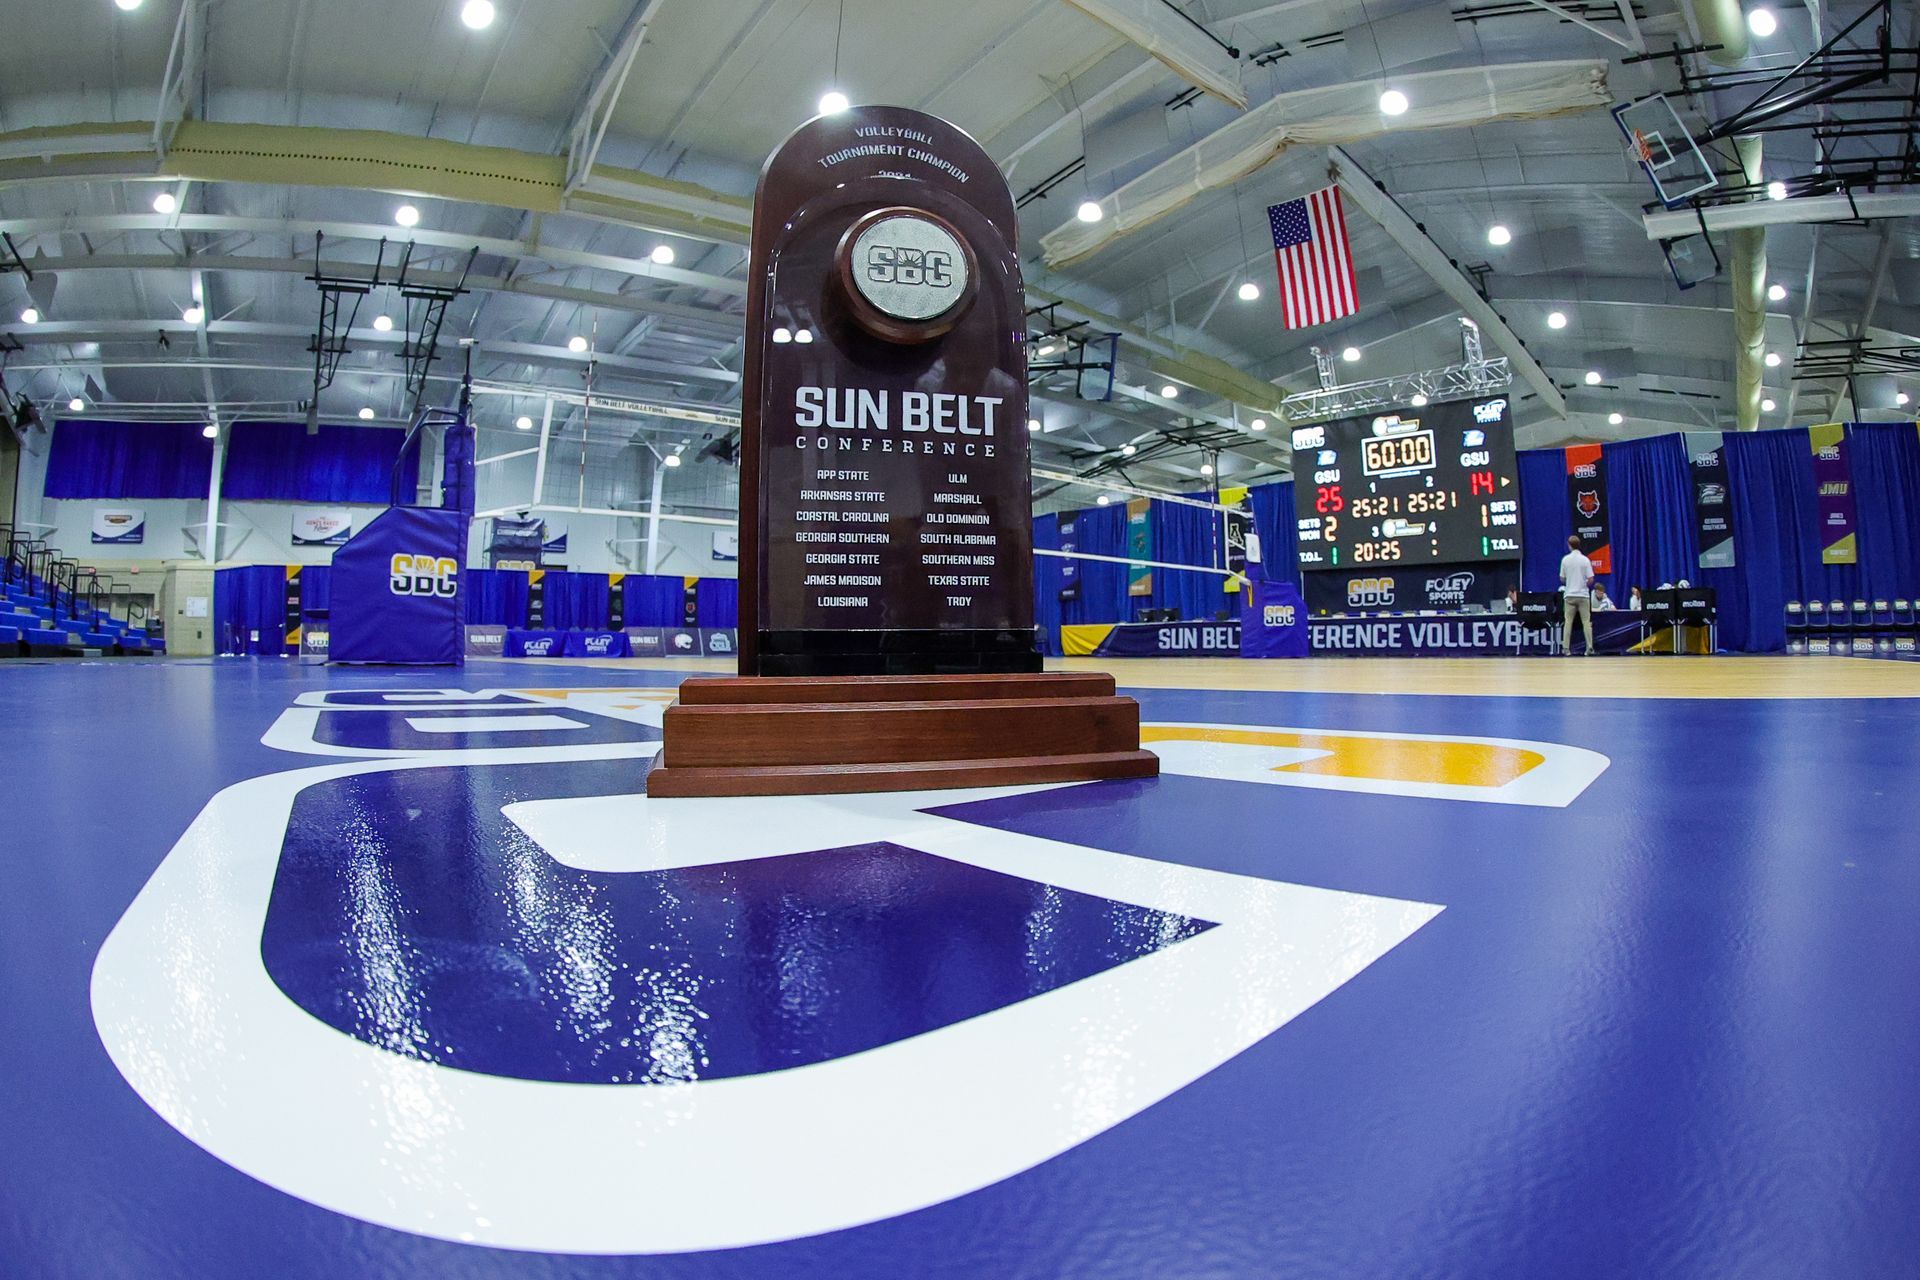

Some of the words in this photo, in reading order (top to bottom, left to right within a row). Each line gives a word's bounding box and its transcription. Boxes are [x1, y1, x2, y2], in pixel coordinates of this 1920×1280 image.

[855, 127, 934, 146] VOLLEYBALL
[817, 144, 904, 169] TOURNAMENT
[907, 148, 970, 183] CHAMPION
[867, 245, 952, 287] SBC
[795, 386, 888, 430] SUN
[902, 391, 1003, 436] BELT
[796, 436, 995, 457] CONFERENCE
[1367, 436, 1430, 469] 60:00
[1460, 451, 1489, 467] GSU
[1696, 453, 1718, 467] SBC
[817, 469, 836, 481] APP
[838, 470, 869, 481] STATE
[1314, 469, 1340, 484] GSU
[1574, 464, 1596, 478] SBC
[948, 473, 967, 484] ULM
[1425, 475, 1434, 487] 2
[1471, 472, 1495, 495] 14
[1369, 482, 1376, 493] 1
[1819, 482, 1849, 496] JMU
[800, 489, 852, 501] ARKANSAS
[854, 491, 885, 502] STATE
[933, 493, 982, 505] MARSHALL
[1316, 486, 1344, 513] 25
[1408, 491, 1456, 513] 25:21
[1352, 496, 1398, 518] 25:21
[1490, 500, 1517, 513] SETS
[796, 510, 840, 522] COASTAL
[842, 512, 889, 523] CAROLINA
[926, 513, 944, 523] OLD
[946, 514, 990, 525] DOMINION
[1491, 514, 1517, 526] WON
[1298, 518, 1321, 529] SETS
[1324, 515, 1337, 541] 2
[1428, 521, 1437, 533] 4
[795, 532, 836, 543] GEORGIA
[838, 533, 890, 544] SOUTHERN
[1298, 529, 1321, 541] WON
[1371, 526, 1379, 537] 3
[920, 533, 951, 544] SOUTH
[953, 534, 996, 545] ALABAMA
[1354, 540, 1400, 562] 20:25
[805, 553, 847, 564] GEORGIA
[848, 554, 880, 565] STATE
[922, 554, 971, 565] SOUTHERN
[973, 555, 995, 566] MISS
[390, 553, 457, 598] SBC
[803, 575, 836, 585] JAMES
[838, 575, 882, 586] MADISON
[928, 575, 958, 585] TEXAS
[960, 576, 990, 586] STATE
[1425, 578, 1471, 592] FOLEY
[1347, 577, 1395, 607] SBC
[1429, 591, 1464, 601] SPORTS
[817, 596, 868, 607] LOUISIANA
[947, 596, 972, 607] TROY
[1646, 602, 1669, 610] molten
[1682, 600, 1706, 608] molten
[1264, 605, 1295, 627] SBC
[471, 634, 485, 643] SUN
[485, 634, 502, 643] BELT
[643, 636, 659, 644] BELT
[1158, 628, 1199, 650] SUN
[1308, 623, 1402, 649] ERENCE
